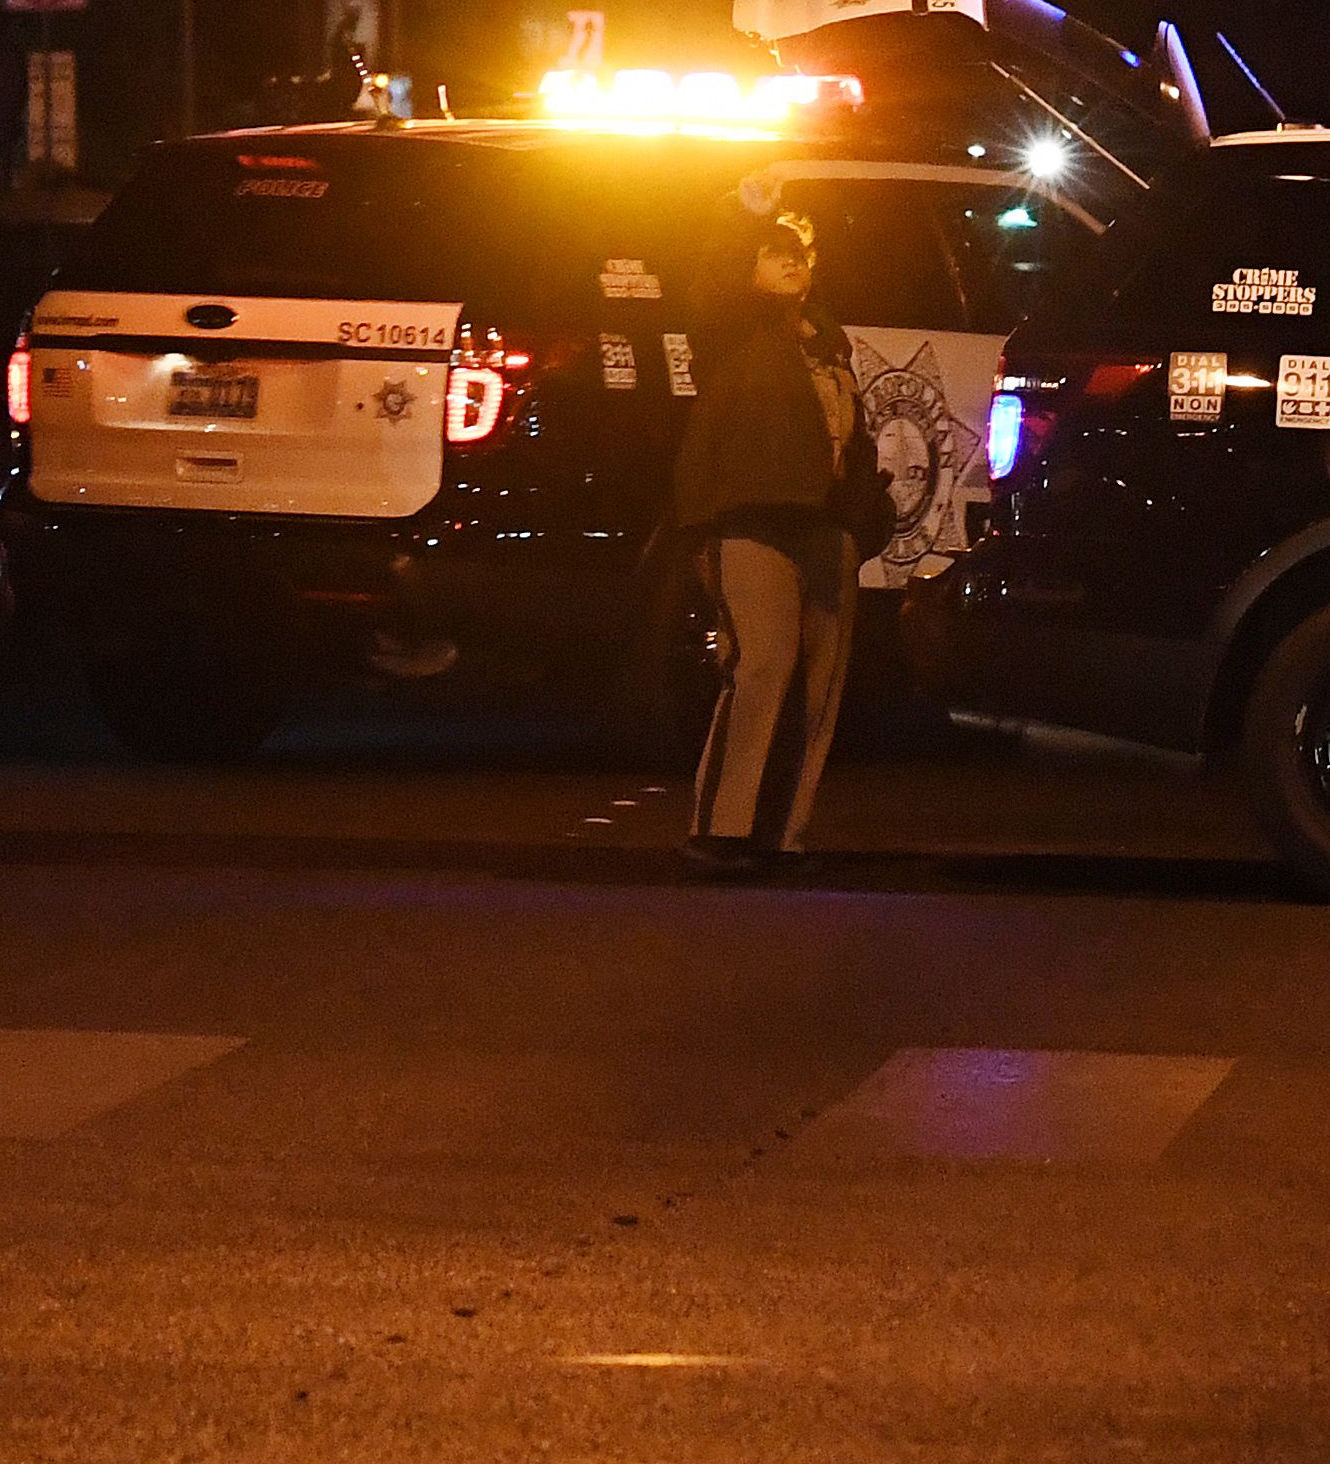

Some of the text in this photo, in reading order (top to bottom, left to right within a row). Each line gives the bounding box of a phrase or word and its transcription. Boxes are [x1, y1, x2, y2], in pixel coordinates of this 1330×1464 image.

[1232, 267, 1299, 286] CRIME
[1211, 284, 1317, 304] STOPPERS
[1176, 355, 1221, 367] DIAL
[1287, 360, 1330, 371] DIAL
[1172, 398, 1218, 411] NON
